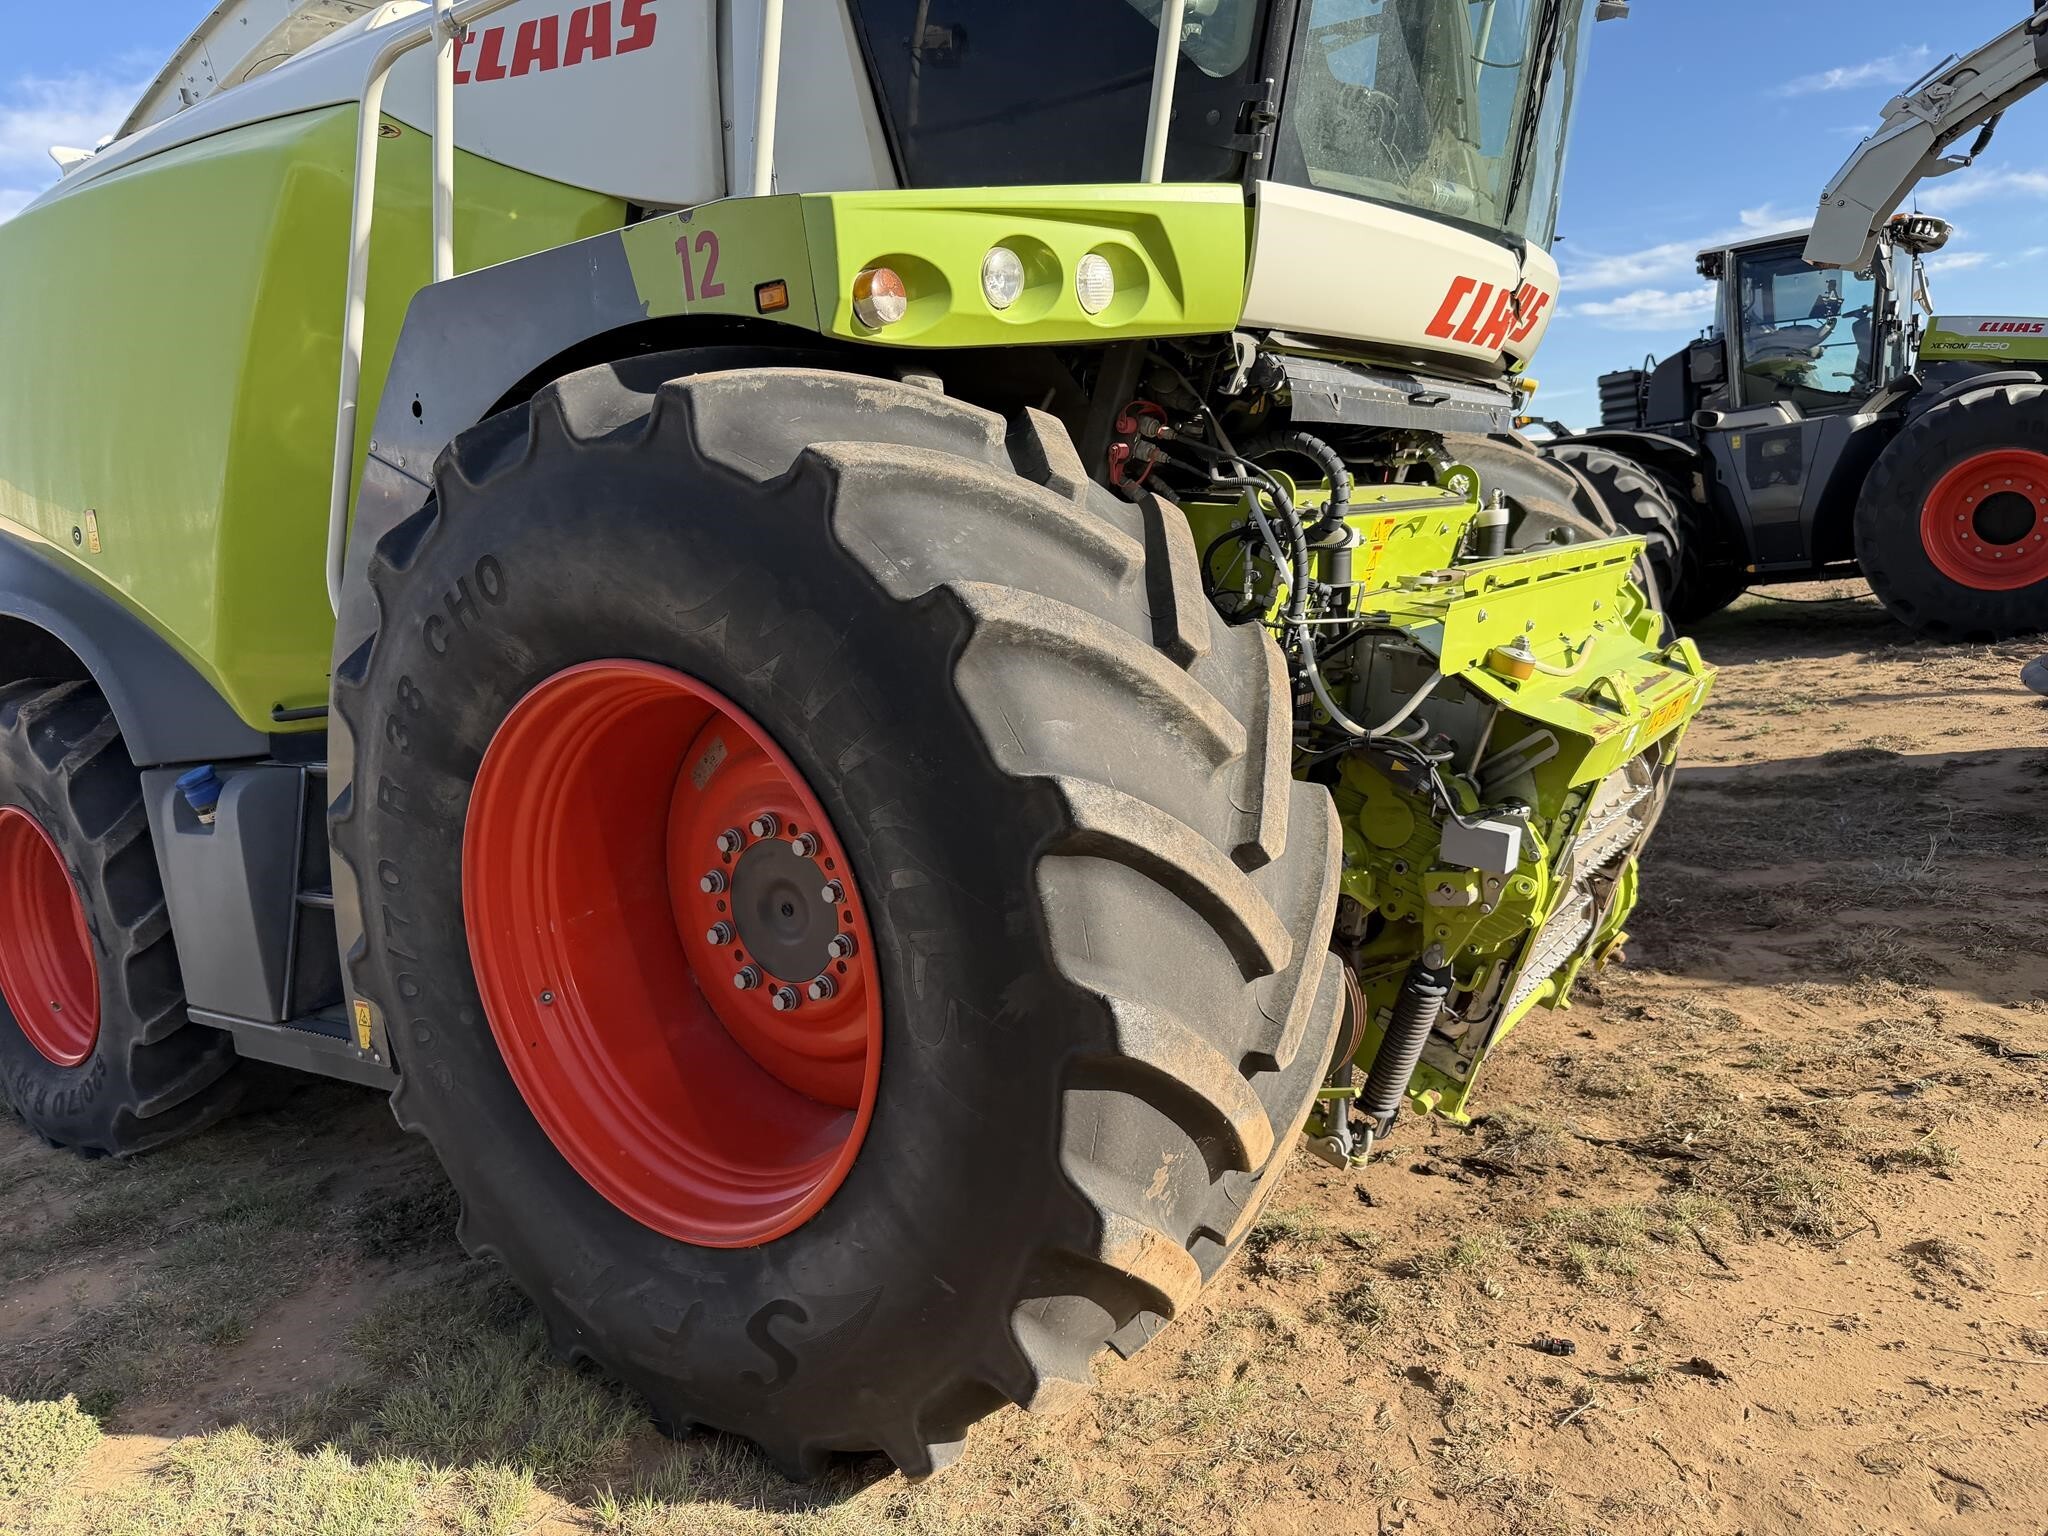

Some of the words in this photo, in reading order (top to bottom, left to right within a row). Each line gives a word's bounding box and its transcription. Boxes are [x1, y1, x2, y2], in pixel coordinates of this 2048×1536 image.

[675, 230, 726, 302] 12
[1978, 322, 2046, 333] CLAAS
[422, 553, 506, 656] CHO
